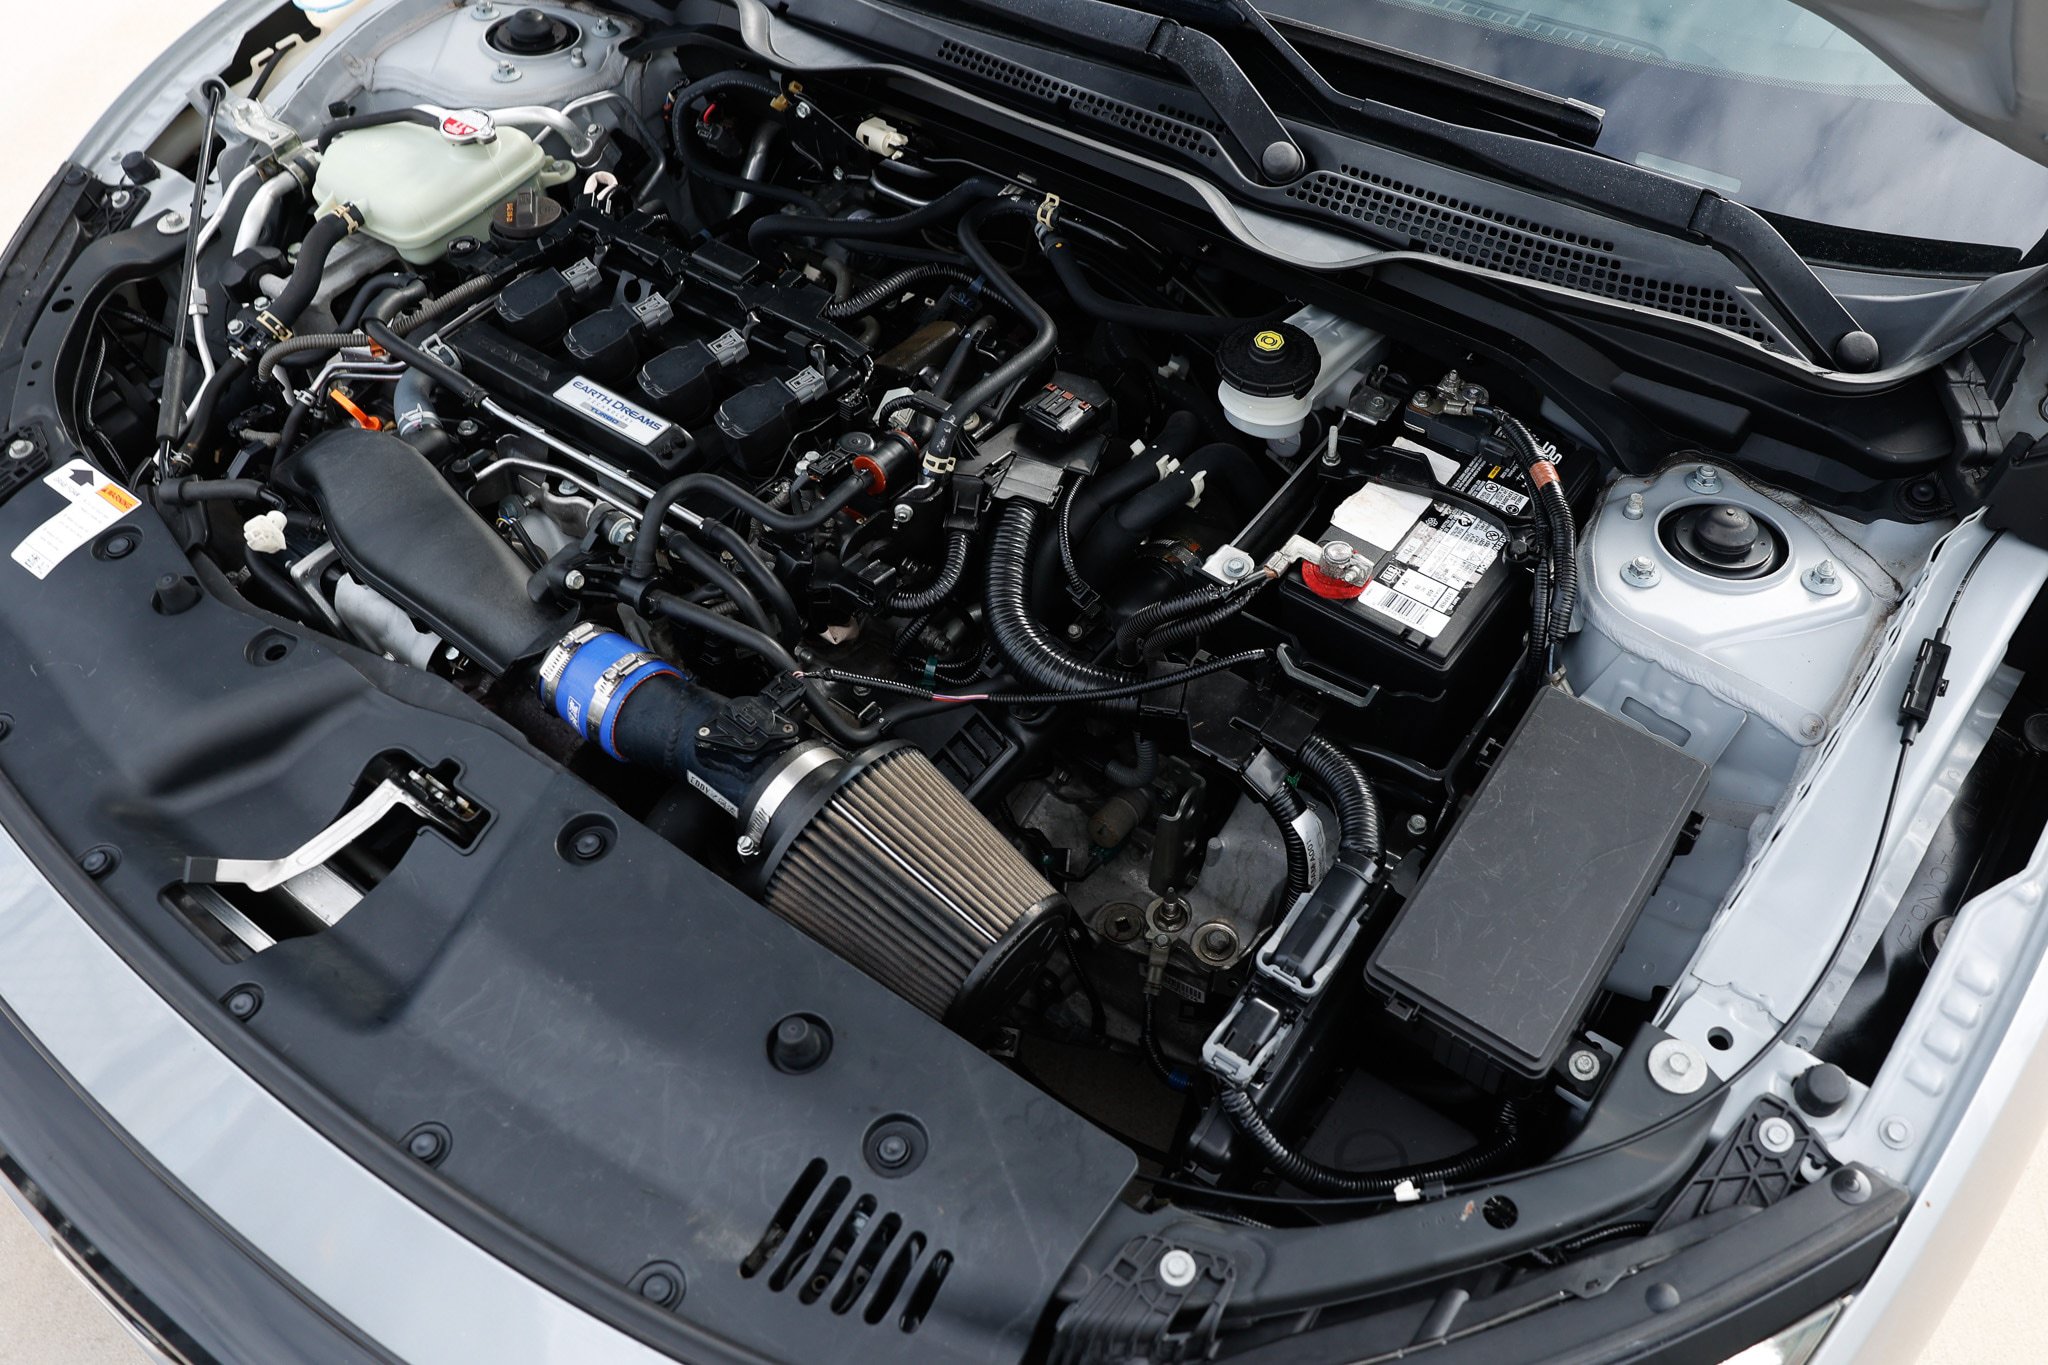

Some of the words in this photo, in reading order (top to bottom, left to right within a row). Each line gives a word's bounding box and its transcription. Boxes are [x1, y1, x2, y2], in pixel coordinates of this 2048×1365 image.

[572, 380, 614, 405] EARTH
[611, 400, 663, 431] DREAMS
[589, 406, 620, 425] TURBO
[690, 775, 710, 794] EDDY
